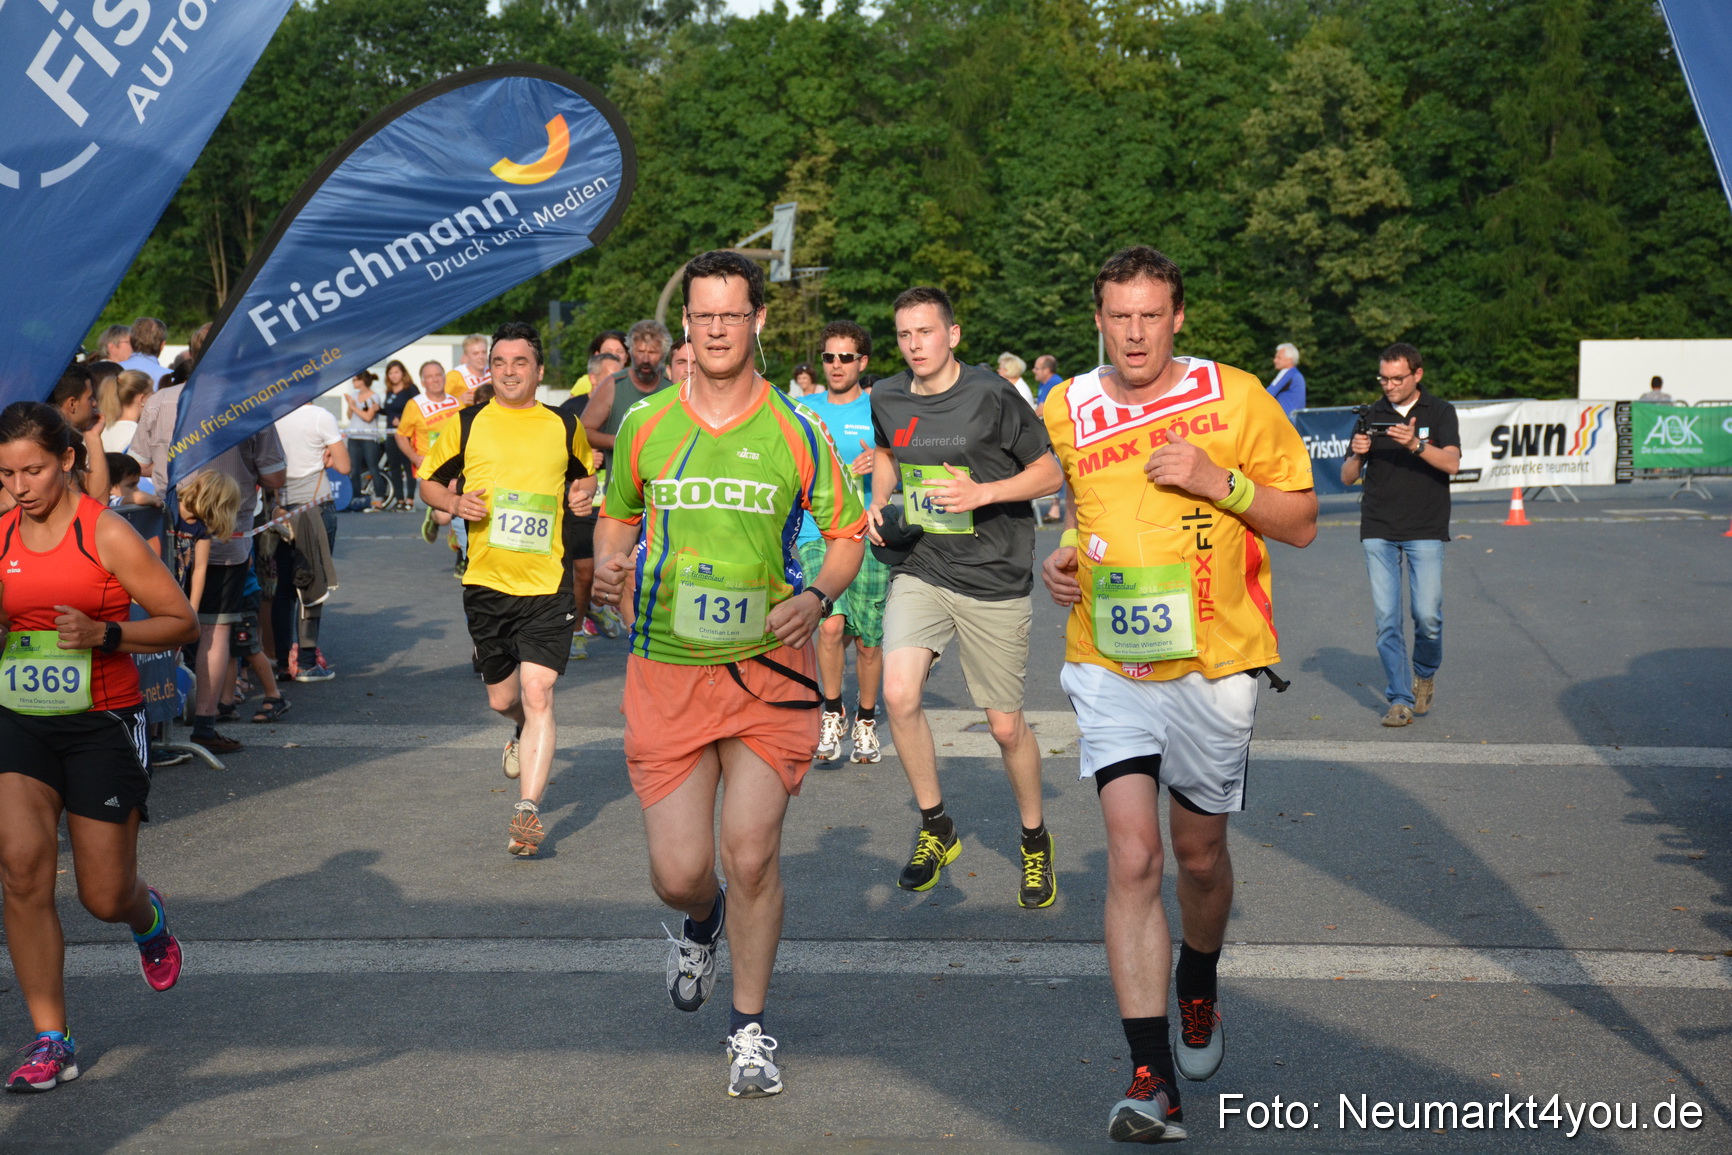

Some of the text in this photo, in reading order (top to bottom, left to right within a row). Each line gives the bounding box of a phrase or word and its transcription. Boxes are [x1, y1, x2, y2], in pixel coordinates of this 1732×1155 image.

[426, 175, 609, 281] Druck und Medien
[247, 190, 519, 346] Frischmann
[911, 436, 967, 447] duerrer.de
[1077, 412, 1229, 478] MAX BÖGL
[1490, 423, 1567, 460] swn
[1643, 415, 1703, 446] AOK
[650, 477, 779, 515] BOCK
[498, 513, 548, 537] 1288
[694, 593, 748, 624] 131
[1111, 603, 1173, 635] 853
[699, 627, 726, 635] Christian
[1114, 641, 1140, 649] Christian
[4, 665, 80, 693] 1369
